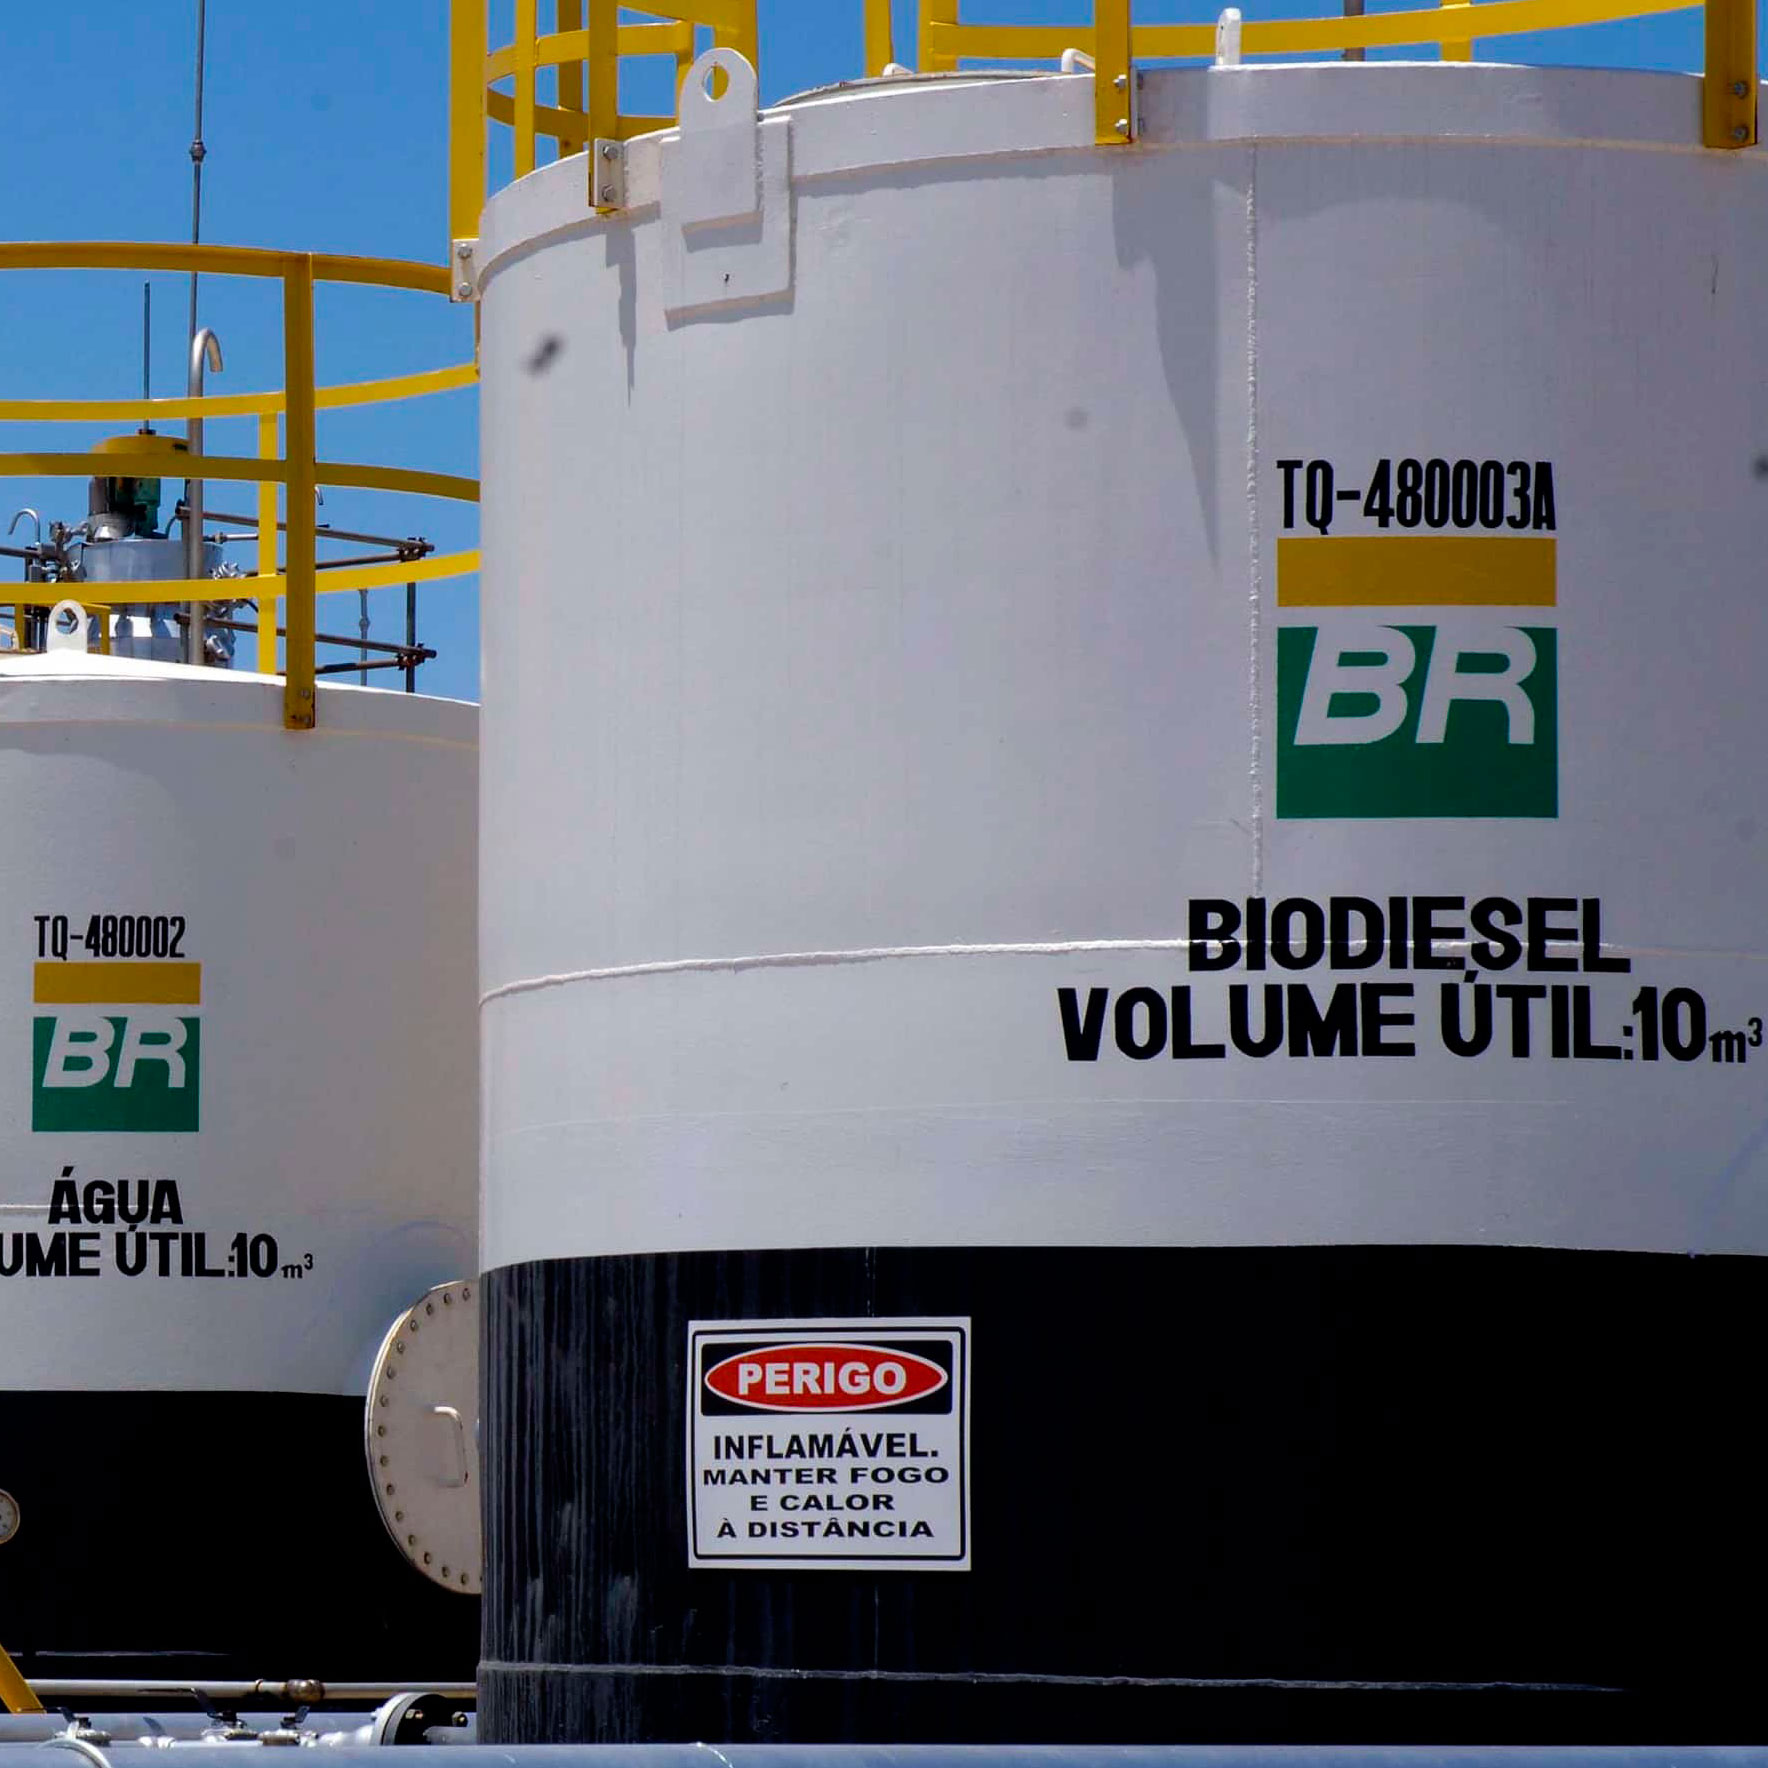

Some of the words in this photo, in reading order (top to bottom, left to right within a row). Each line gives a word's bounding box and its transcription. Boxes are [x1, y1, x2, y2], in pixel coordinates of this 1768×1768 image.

[1276, 458, 1557, 536] TQ-480003A
[1293, 625, 1537, 746] BR
[33, 914, 186, 962] TQ-480002
[1188, 896, 1632, 974] BIODIESEL
[1057, 982, 1416, 1062] VOLUME
[41, 1016, 187, 1089] BR
[47, 1166, 184, 1227] ÁGUA
[738, 1361, 907, 1395] PERIGO
[713, 1427, 939, 1460] INFLAMÁVEL.
[703, 1467, 838, 1486] MANTER
[850, 1466, 949, 1484] FOGO
[750, 1495, 768, 1512] E
[779, 1493, 895, 1511] CALOR
[716, 1517, 737, 1539] À
[748, 1517, 935, 1538] DISTÂNCIA
